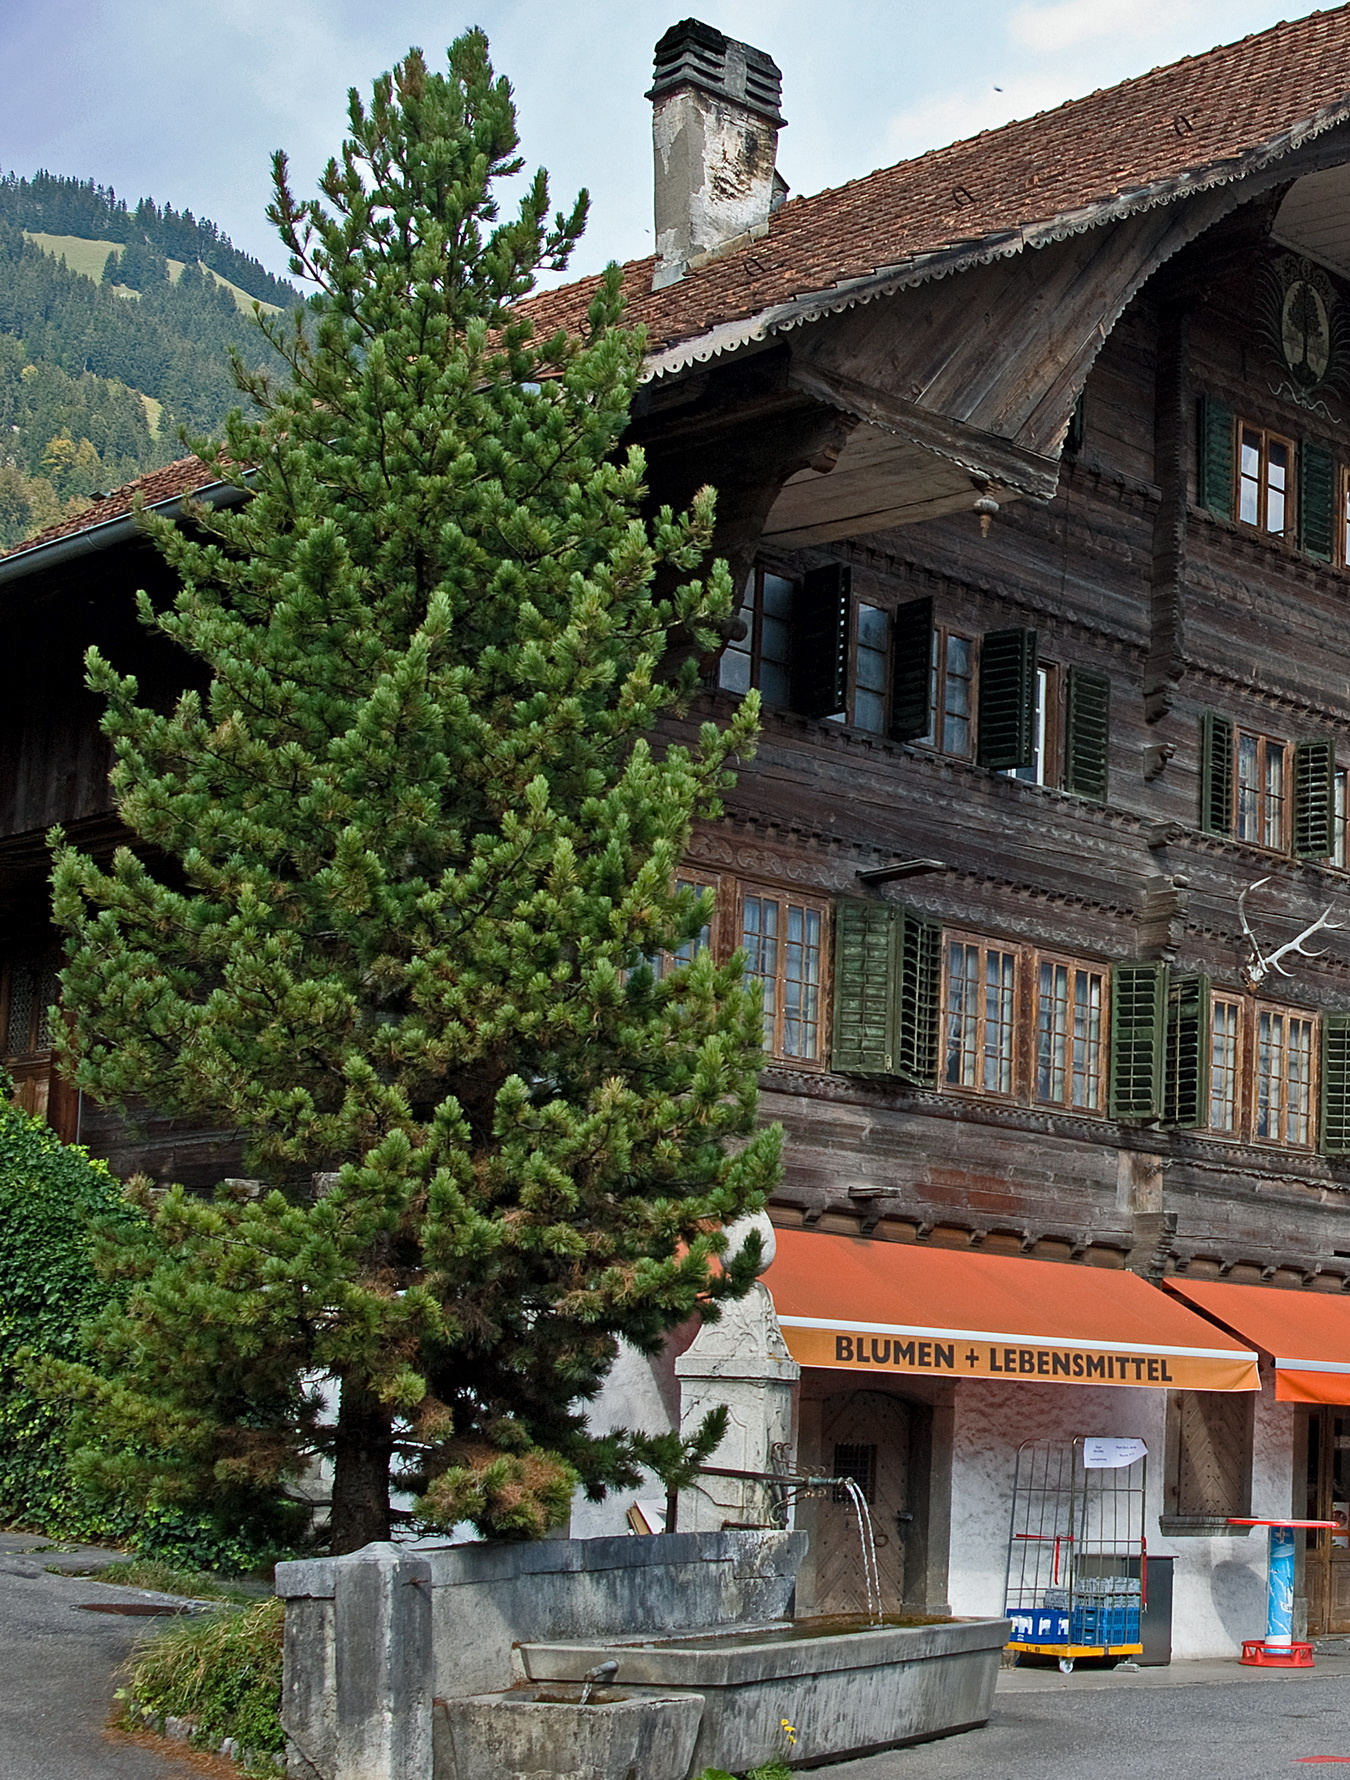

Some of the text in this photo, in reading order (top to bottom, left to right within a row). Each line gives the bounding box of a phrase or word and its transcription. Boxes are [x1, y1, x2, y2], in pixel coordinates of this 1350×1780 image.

[836, 1335, 1173, 1382] BLUMEN + LEBENSMITTEL
